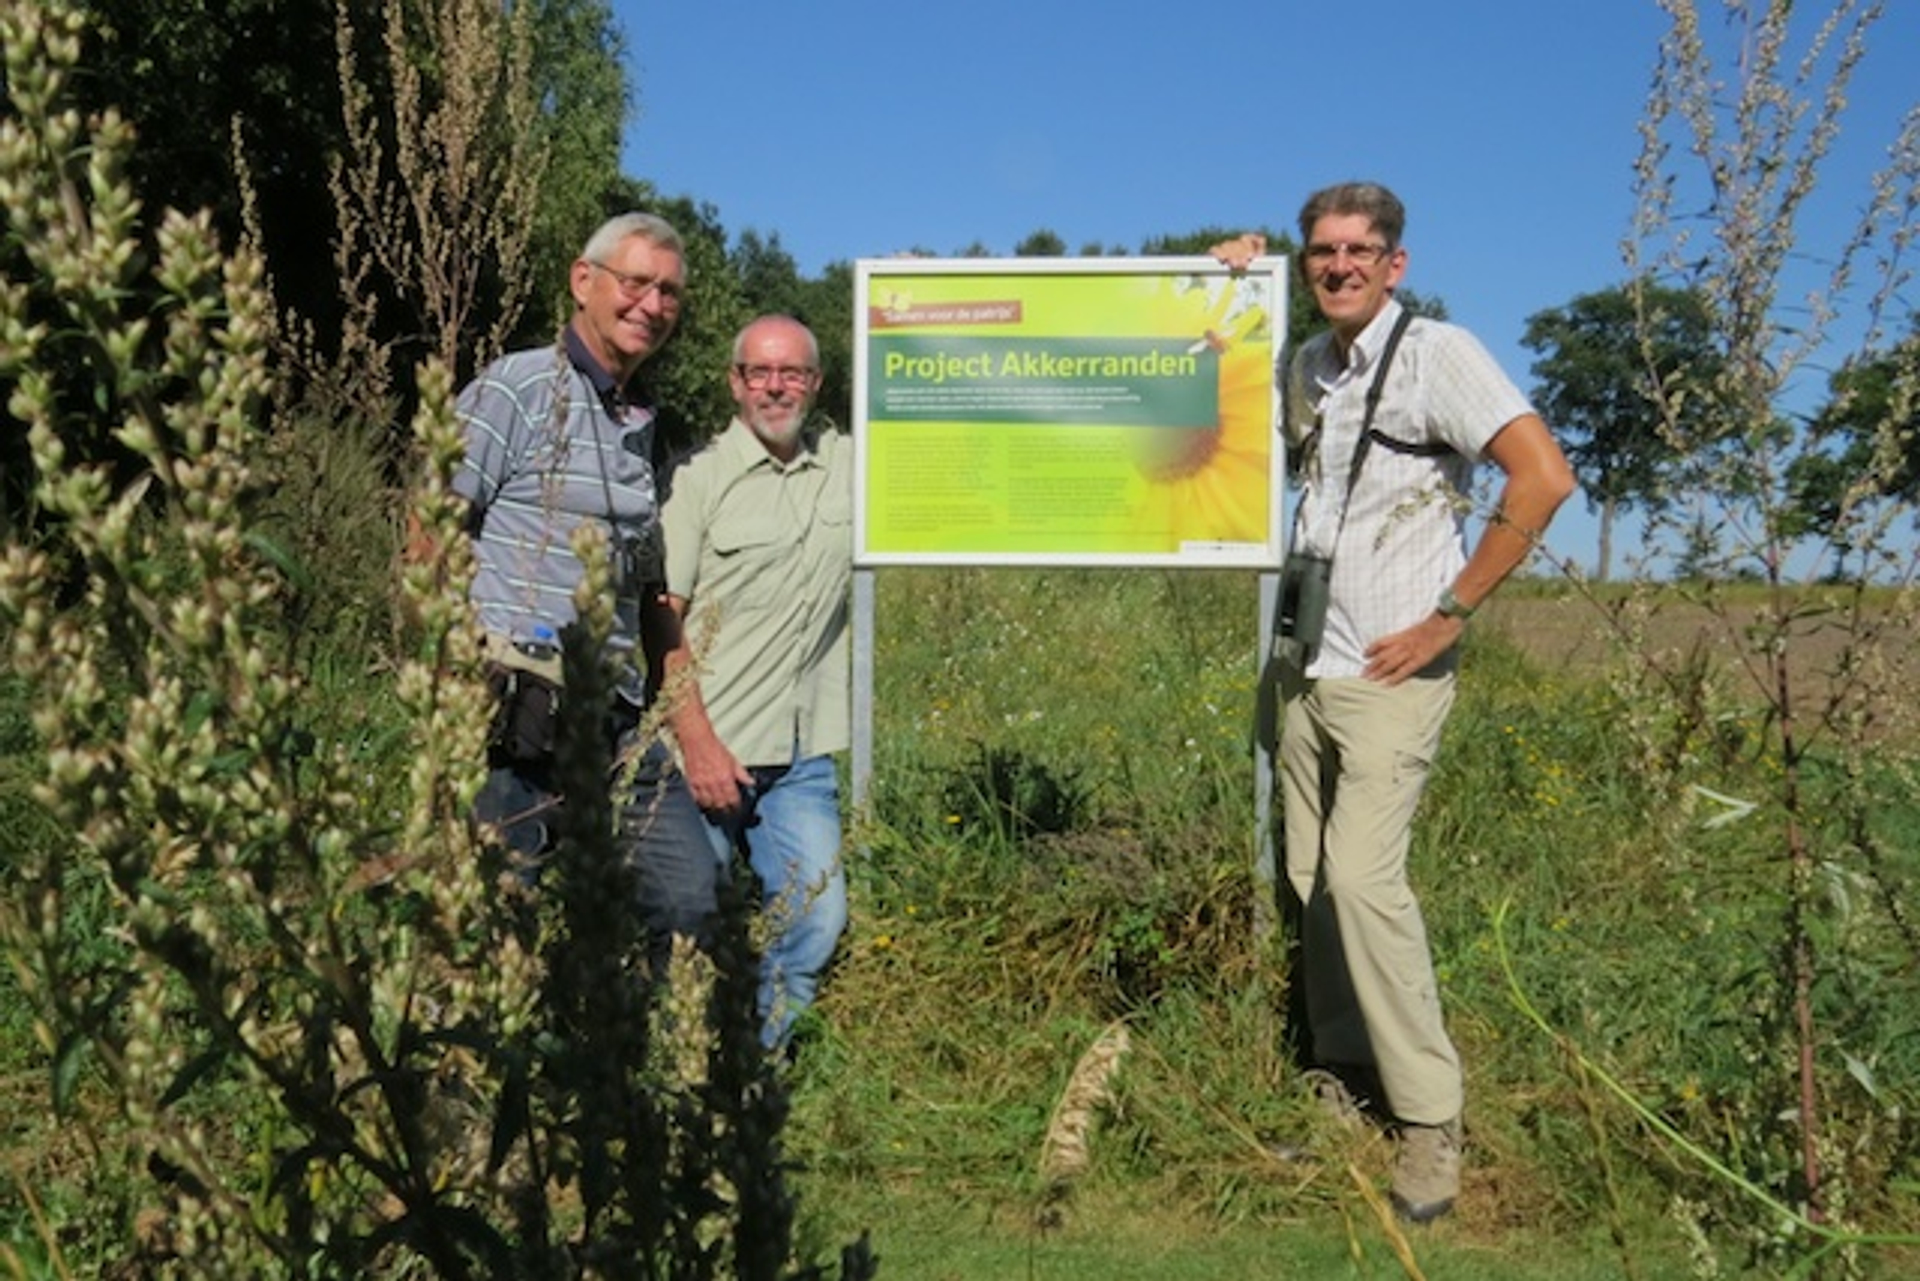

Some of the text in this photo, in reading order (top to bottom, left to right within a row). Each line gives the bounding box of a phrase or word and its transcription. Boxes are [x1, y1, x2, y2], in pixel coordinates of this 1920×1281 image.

[927, 310, 953, 321] voor
[956, 308, 971, 320] de
[885, 350, 1196, 383] Project Akkerranden
